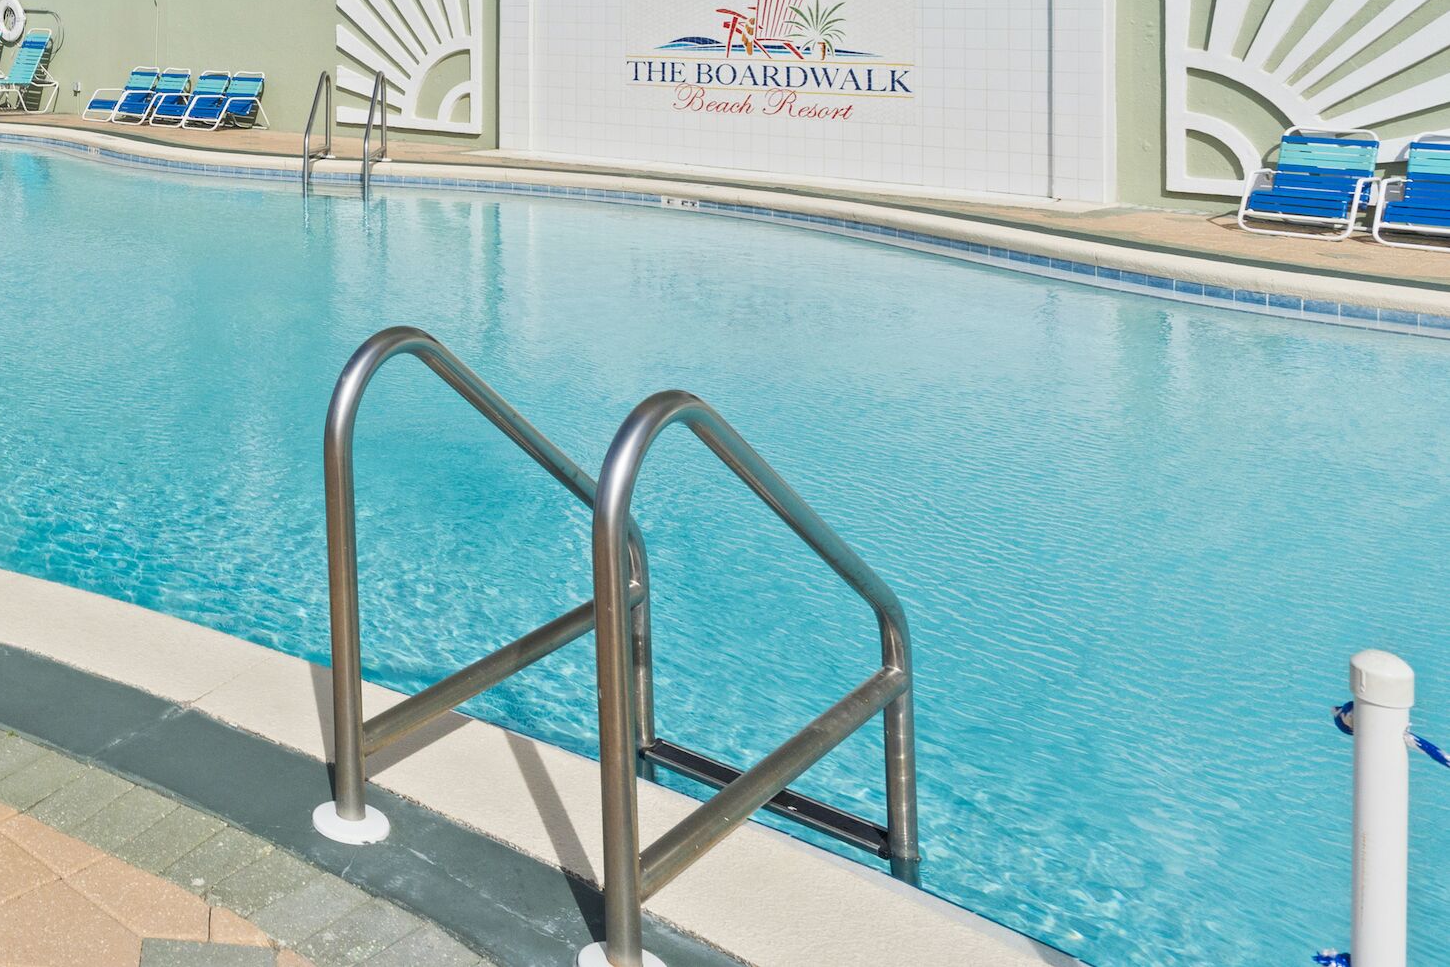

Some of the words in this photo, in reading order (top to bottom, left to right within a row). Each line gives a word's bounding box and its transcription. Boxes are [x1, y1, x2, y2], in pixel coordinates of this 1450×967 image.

[626, 60, 686, 83] THE
[696, 63, 912, 93] BOARDWALK
[673, 83, 754, 114] Beach
[762, 87, 854, 120] Resort
